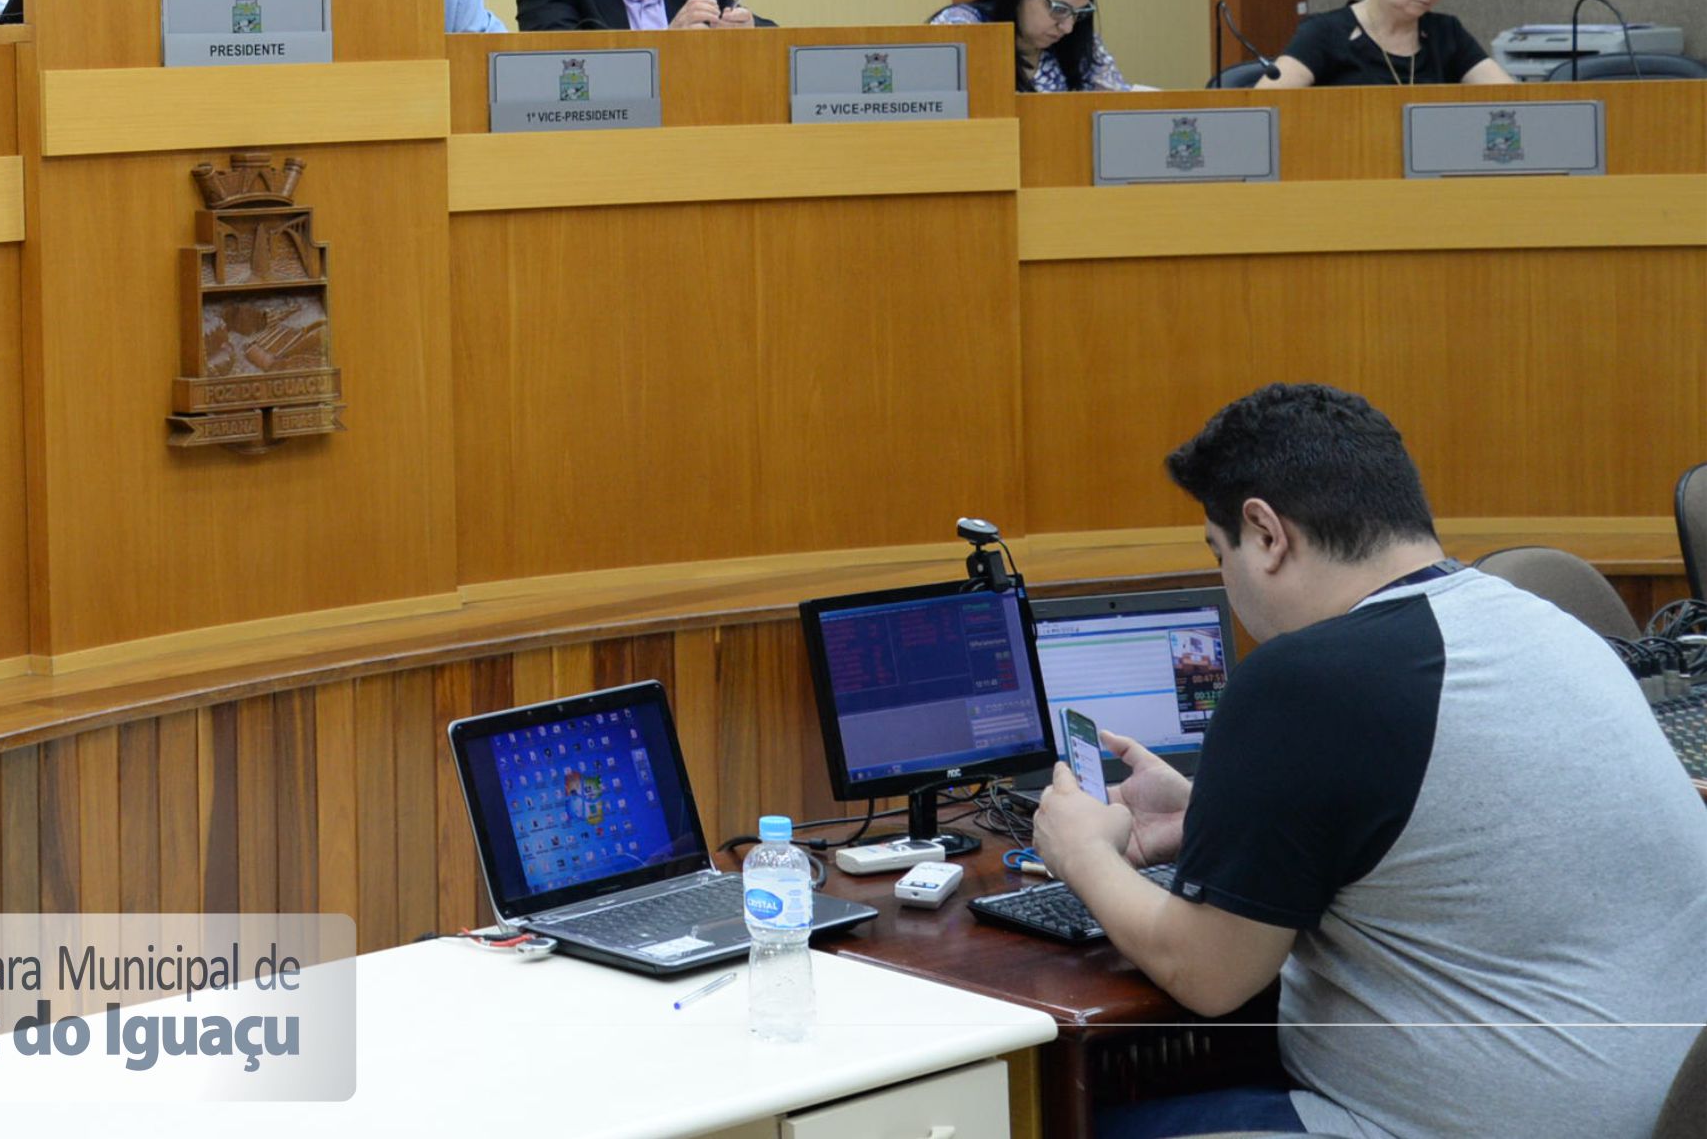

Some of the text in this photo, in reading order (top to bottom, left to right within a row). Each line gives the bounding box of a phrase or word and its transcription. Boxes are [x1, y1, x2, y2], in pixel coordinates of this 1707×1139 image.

[209, 42, 285, 57] PRESIDENTE
[538, 108, 628, 122] VICE-PRESIDENTE
[830, 100, 943, 115] VICE-PRESIDENTE
[204, 383, 237, 403] FOZ
[242, 381, 261, 400] DO
